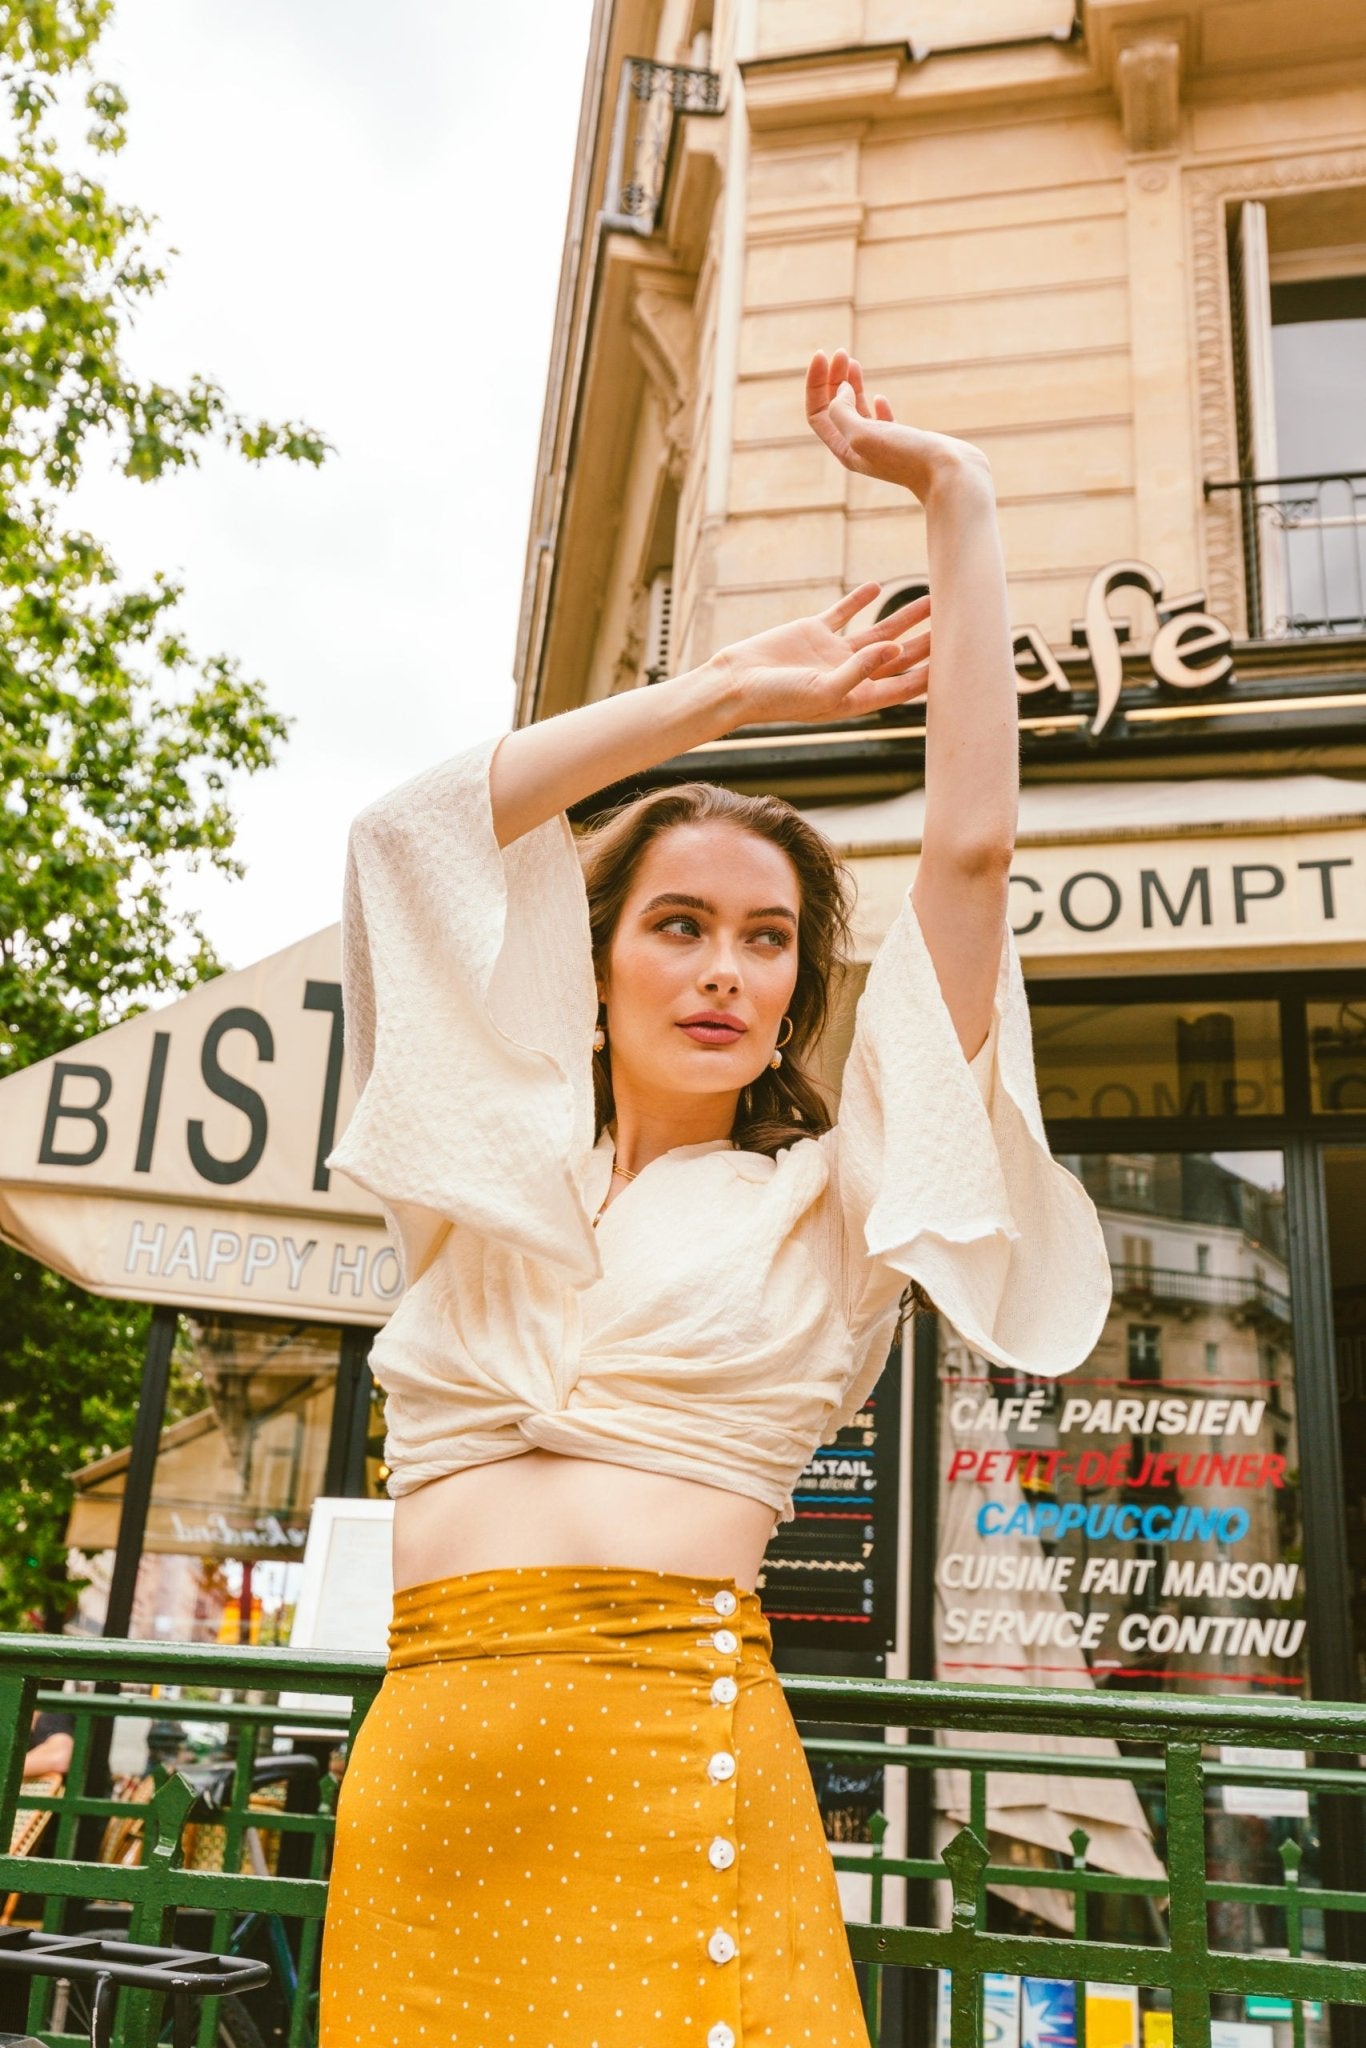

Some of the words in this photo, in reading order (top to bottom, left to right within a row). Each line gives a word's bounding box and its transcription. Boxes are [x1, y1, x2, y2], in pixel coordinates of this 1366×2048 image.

[38, 980, 345, 1192] BIST
[125, 1220, 318, 1291] HAPPY
[950, 1390, 1046, 1433] CAFÉ
[1058, 1399, 1267, 1437] PARISIEN
[946, 1442, 1287, 1490] PETIT-DÉJEUNER
[976, 1502, 1251, 1544] CAPPUCCINO
[940, 1553, 1076, 1593] CUISINE
[1079, 1557, 1157, 1595] FAIT
[1161, 1559, 1299, 1601] MAISON
[942, 1608, 1110, 1649] SERVICE
[1118, 1613, 1307, 1658] CONTINU
